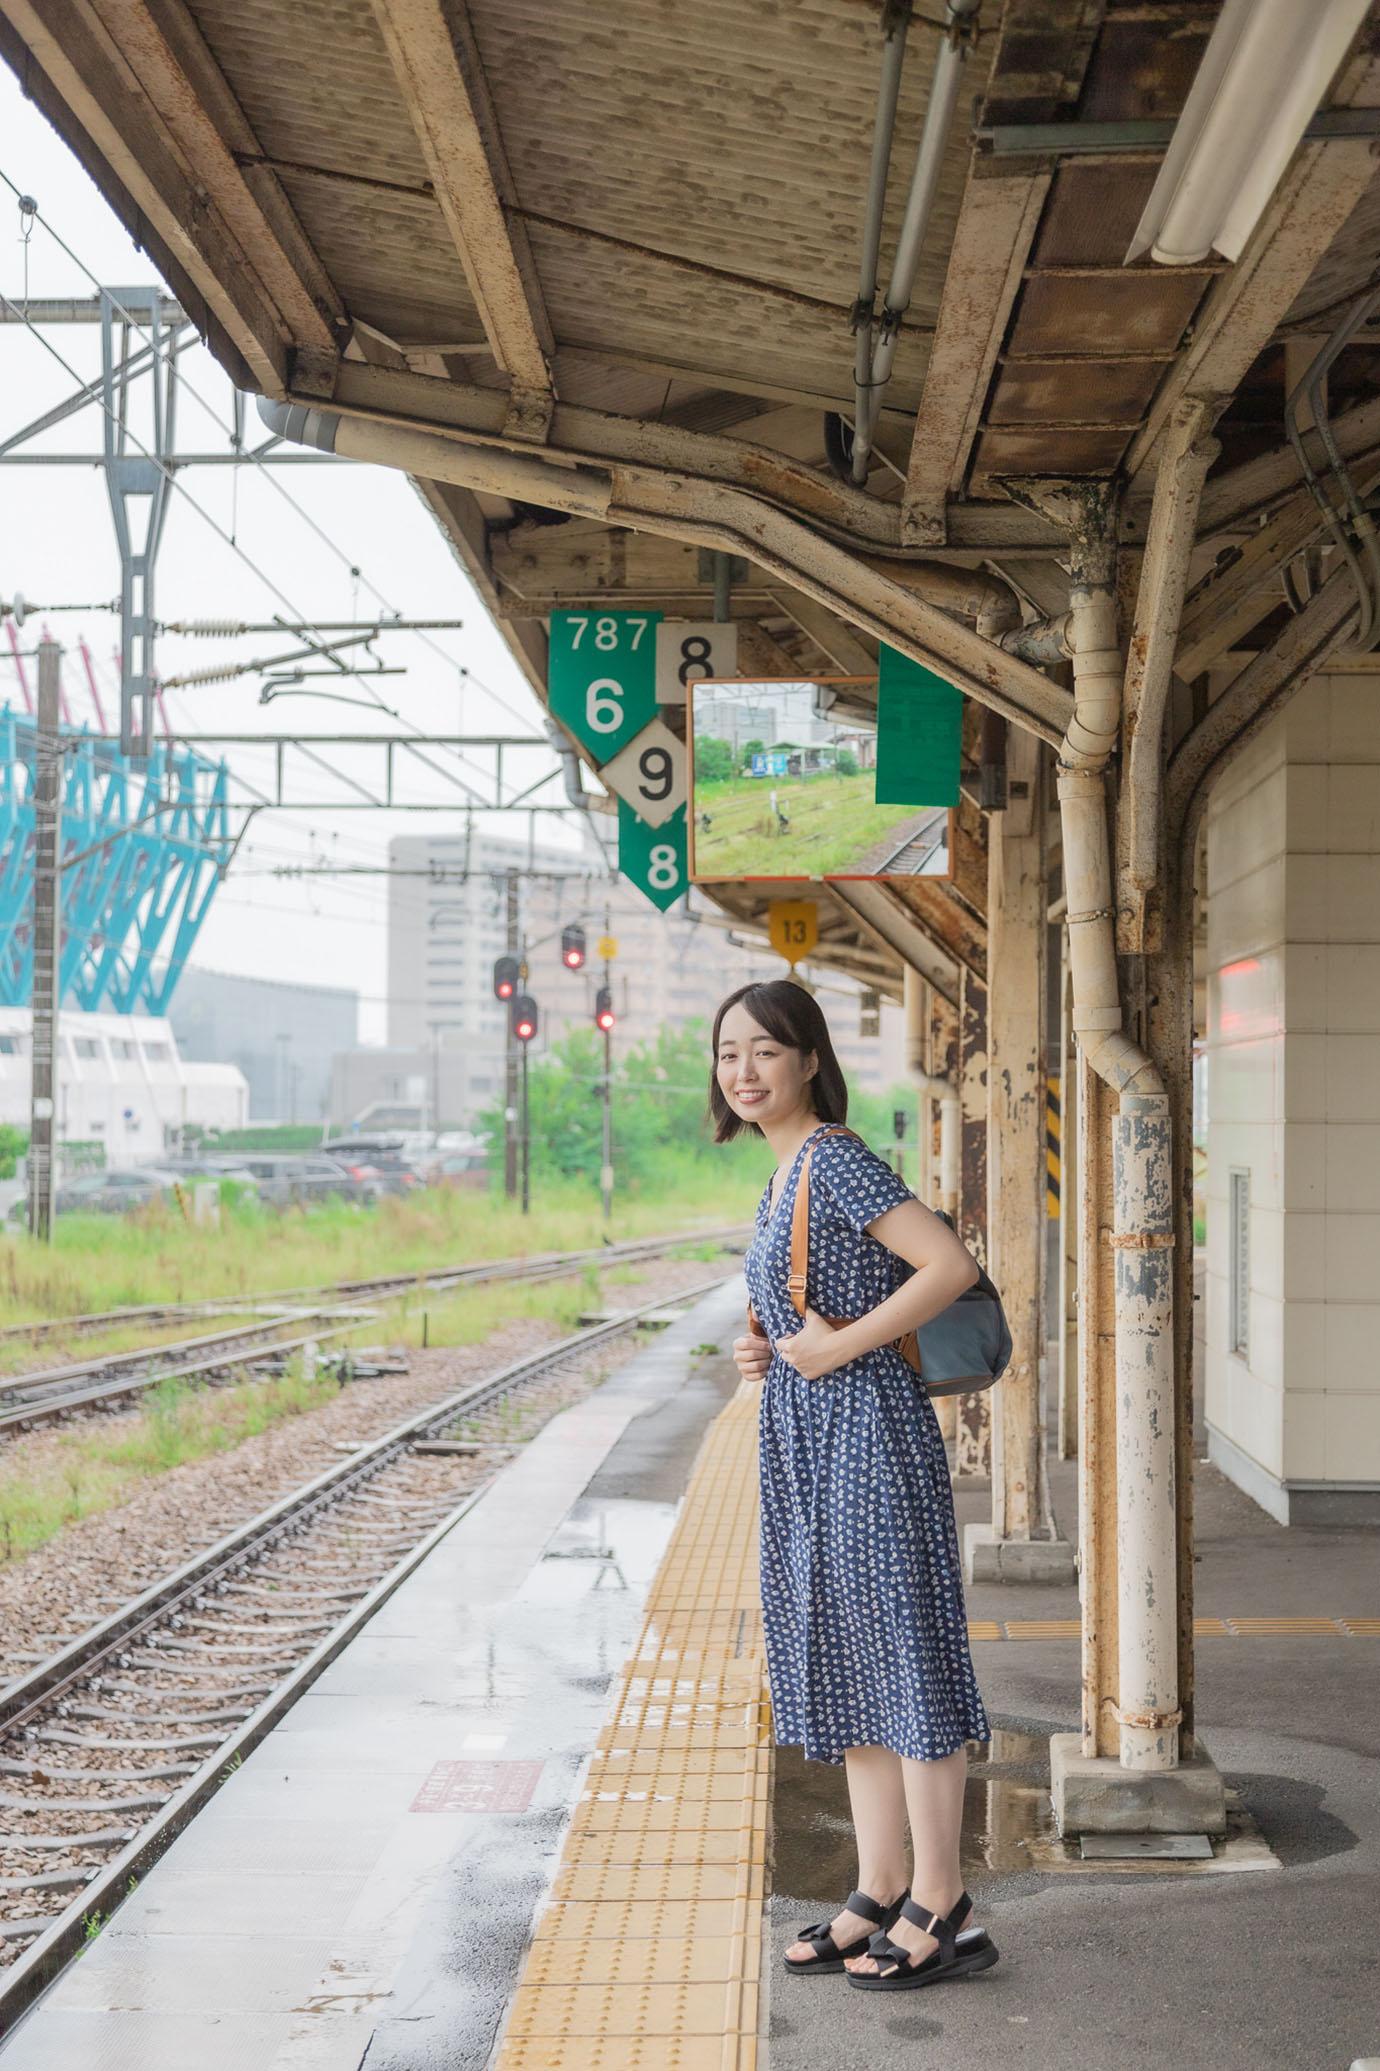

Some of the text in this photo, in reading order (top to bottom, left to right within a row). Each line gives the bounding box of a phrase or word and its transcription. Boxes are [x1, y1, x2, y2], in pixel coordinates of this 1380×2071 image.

[566, 617, 648, 651] 787
[679, 636, 714, 687] 8
[586, 678, 624, 734] 6
[638, 747, 673, 801] 9
[647, 844, 679, 890] 8
[784, 920, 807, 945] 13
